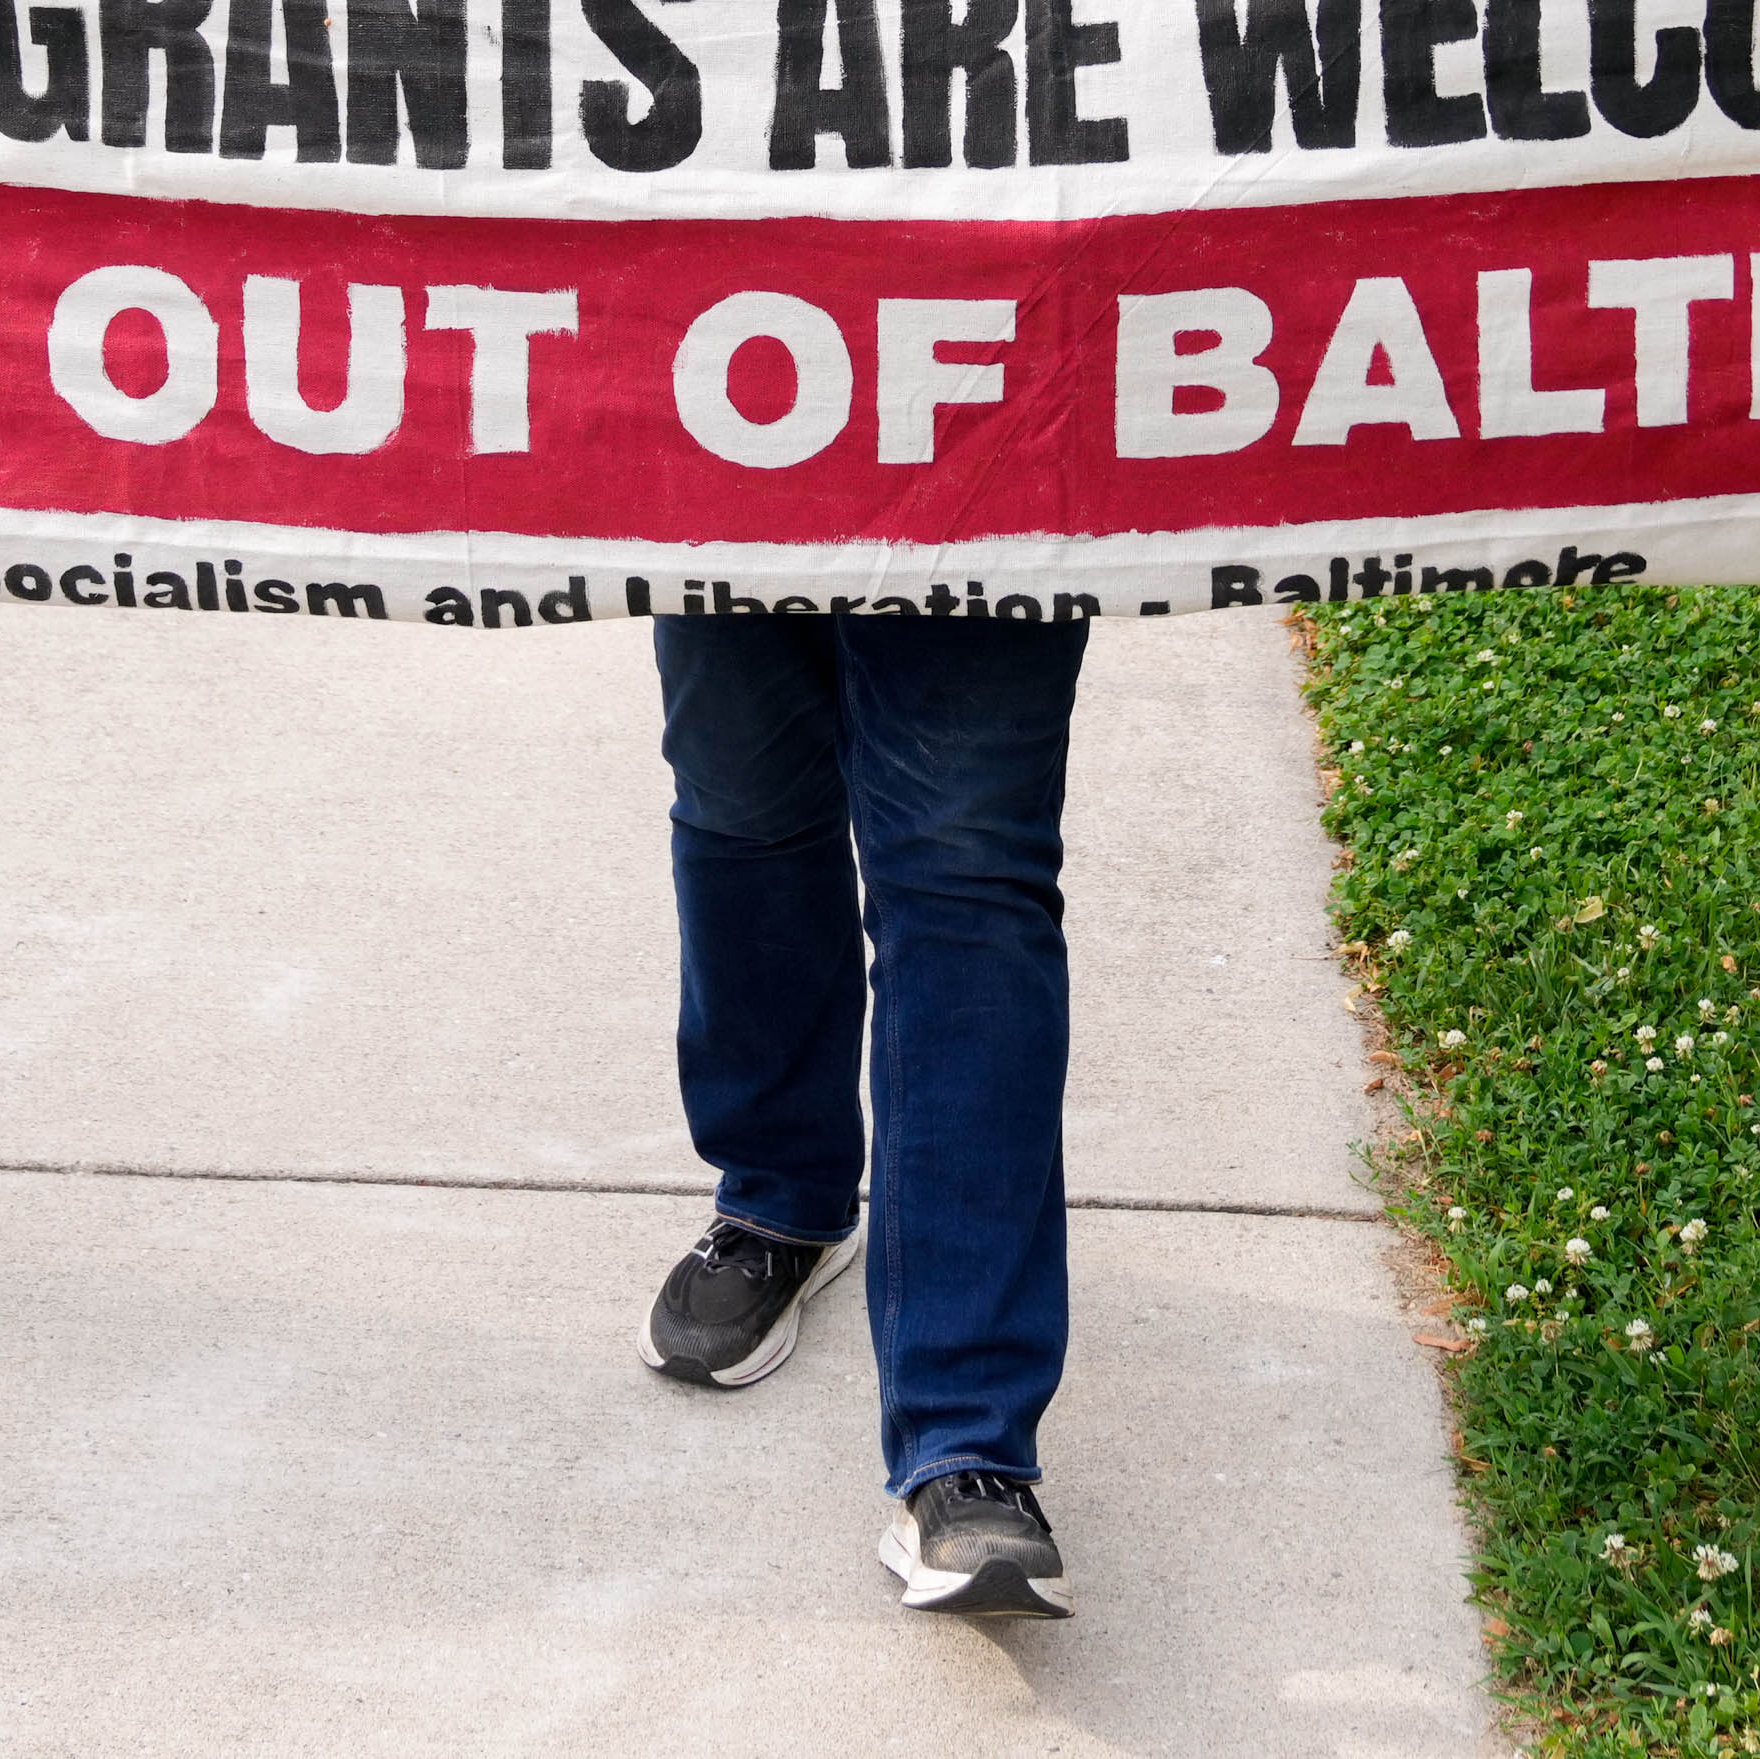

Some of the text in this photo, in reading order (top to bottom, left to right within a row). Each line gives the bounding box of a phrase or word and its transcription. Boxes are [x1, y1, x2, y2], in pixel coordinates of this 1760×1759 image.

[46, 265, 580, 457] OUT
[672, 290, 1018, 471] OF
[424, 575, 591, 629] and
[1211, 546, 1647, 609] Baltimore
